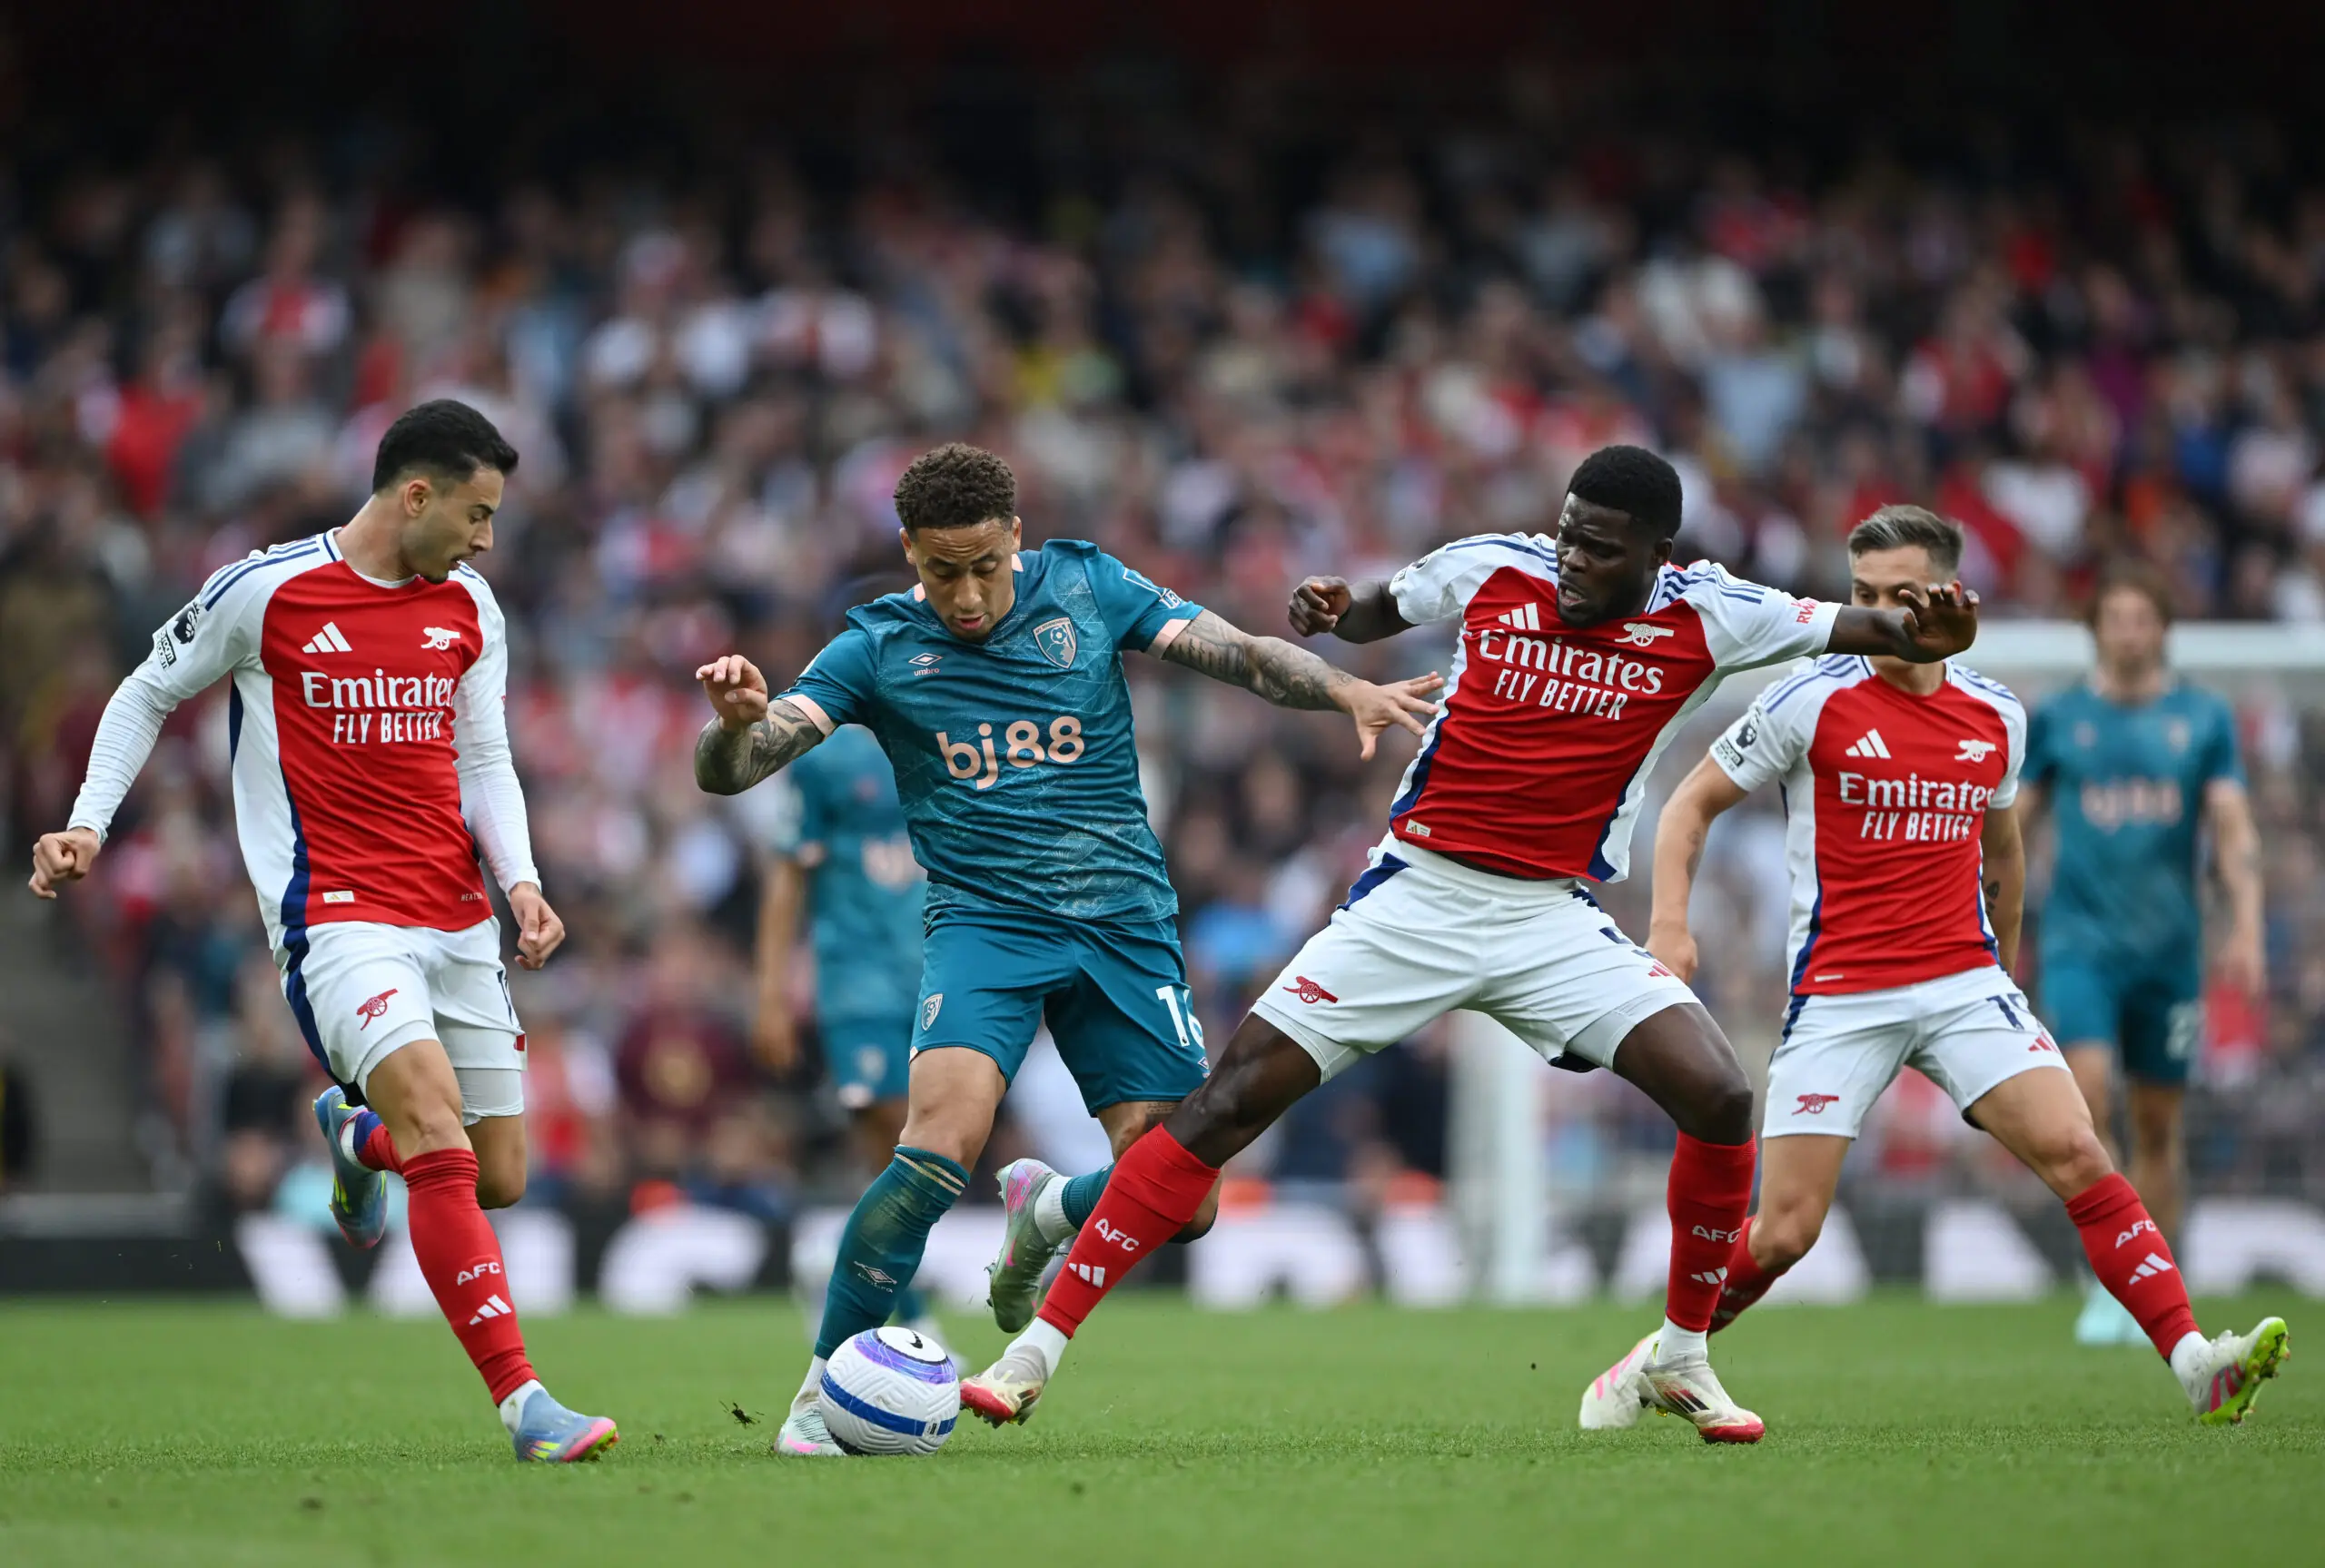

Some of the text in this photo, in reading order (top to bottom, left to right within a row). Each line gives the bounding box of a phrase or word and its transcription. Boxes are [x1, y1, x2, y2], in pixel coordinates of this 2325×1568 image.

[914, 667, 940, 676] umbro
[1479, 629, 1664, 695] Emirates
[1494, 668, 1628, 721] FLY BETTER
[333, 711, 445, 744] FLY BETTER
[935, 715, 1085, 790] bj88
[1860, 811, 1974, 842] FLY BETTER
[1095, 1218, 1140, 1252] AFC
[457, 1262, 501, 1286] AFC
